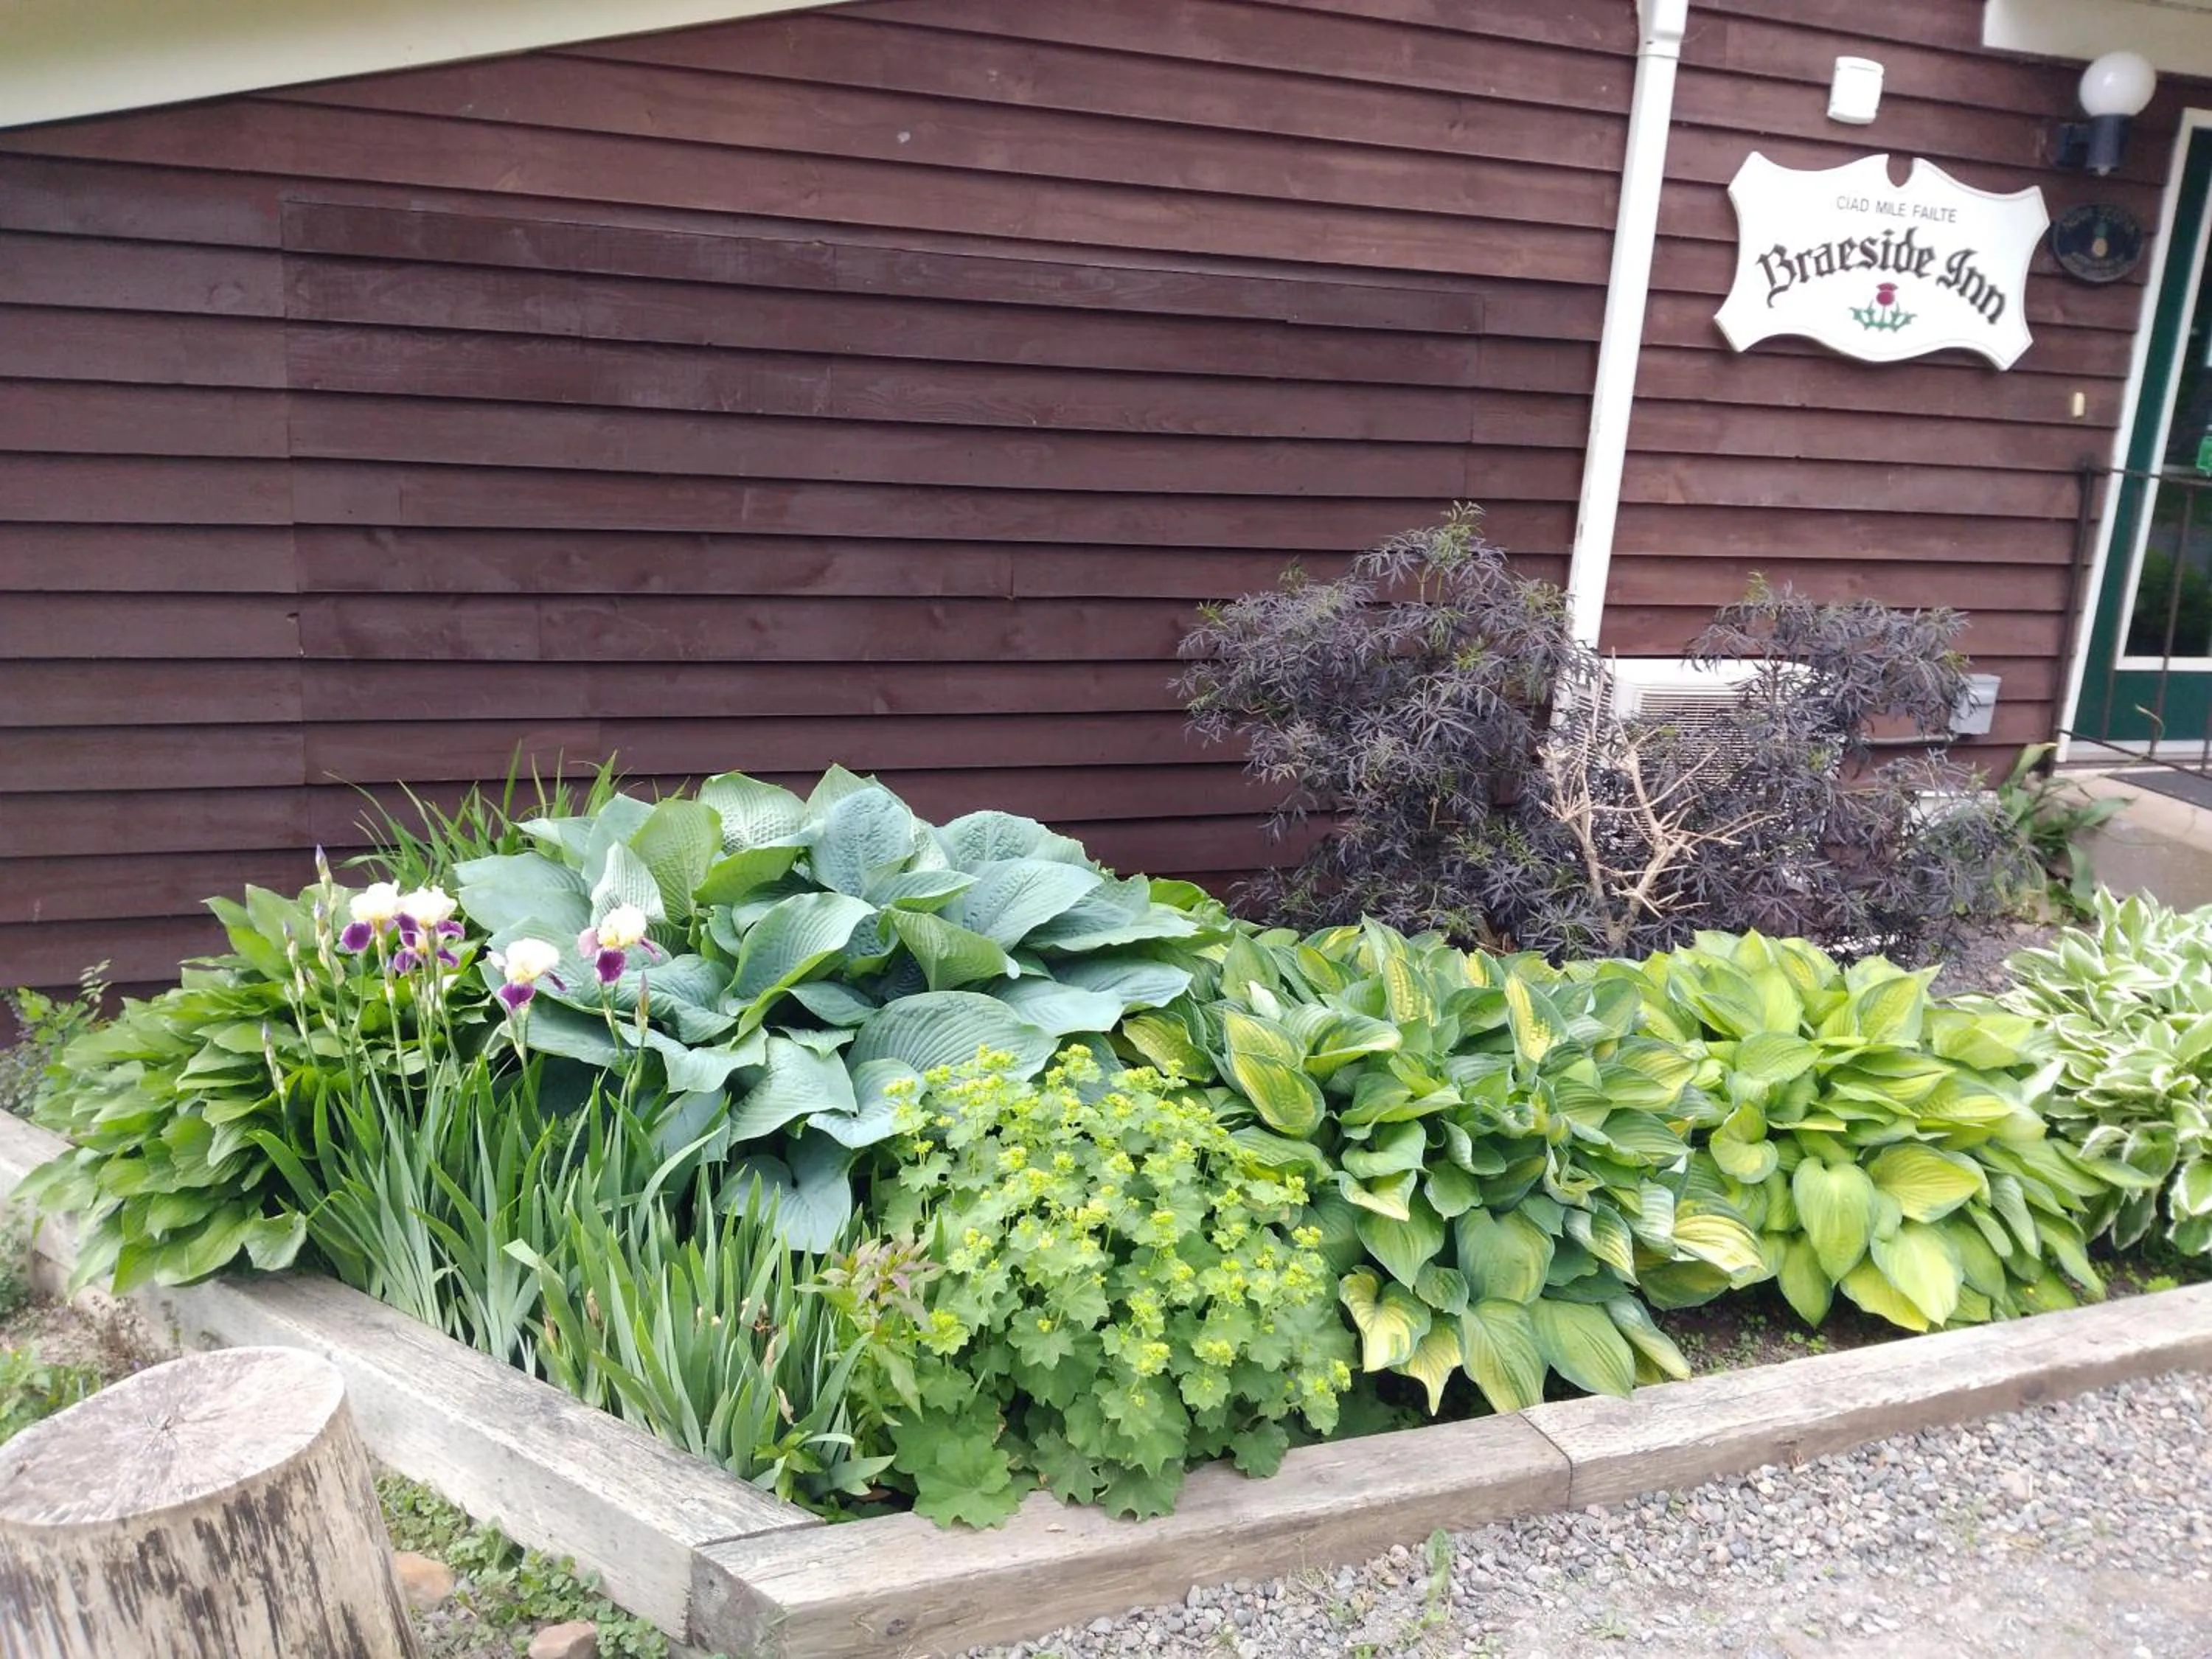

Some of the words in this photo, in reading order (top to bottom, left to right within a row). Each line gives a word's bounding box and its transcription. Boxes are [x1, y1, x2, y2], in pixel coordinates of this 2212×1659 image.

[1837, 195, 1869, 212] CIAD
[1875, 200, 1906, 218] MILE
[1913, 204, 1958, 223] FAILTE
[1756, 226, 1935, 308] Braeside
[1936, 248, 2006, 324] Inn
